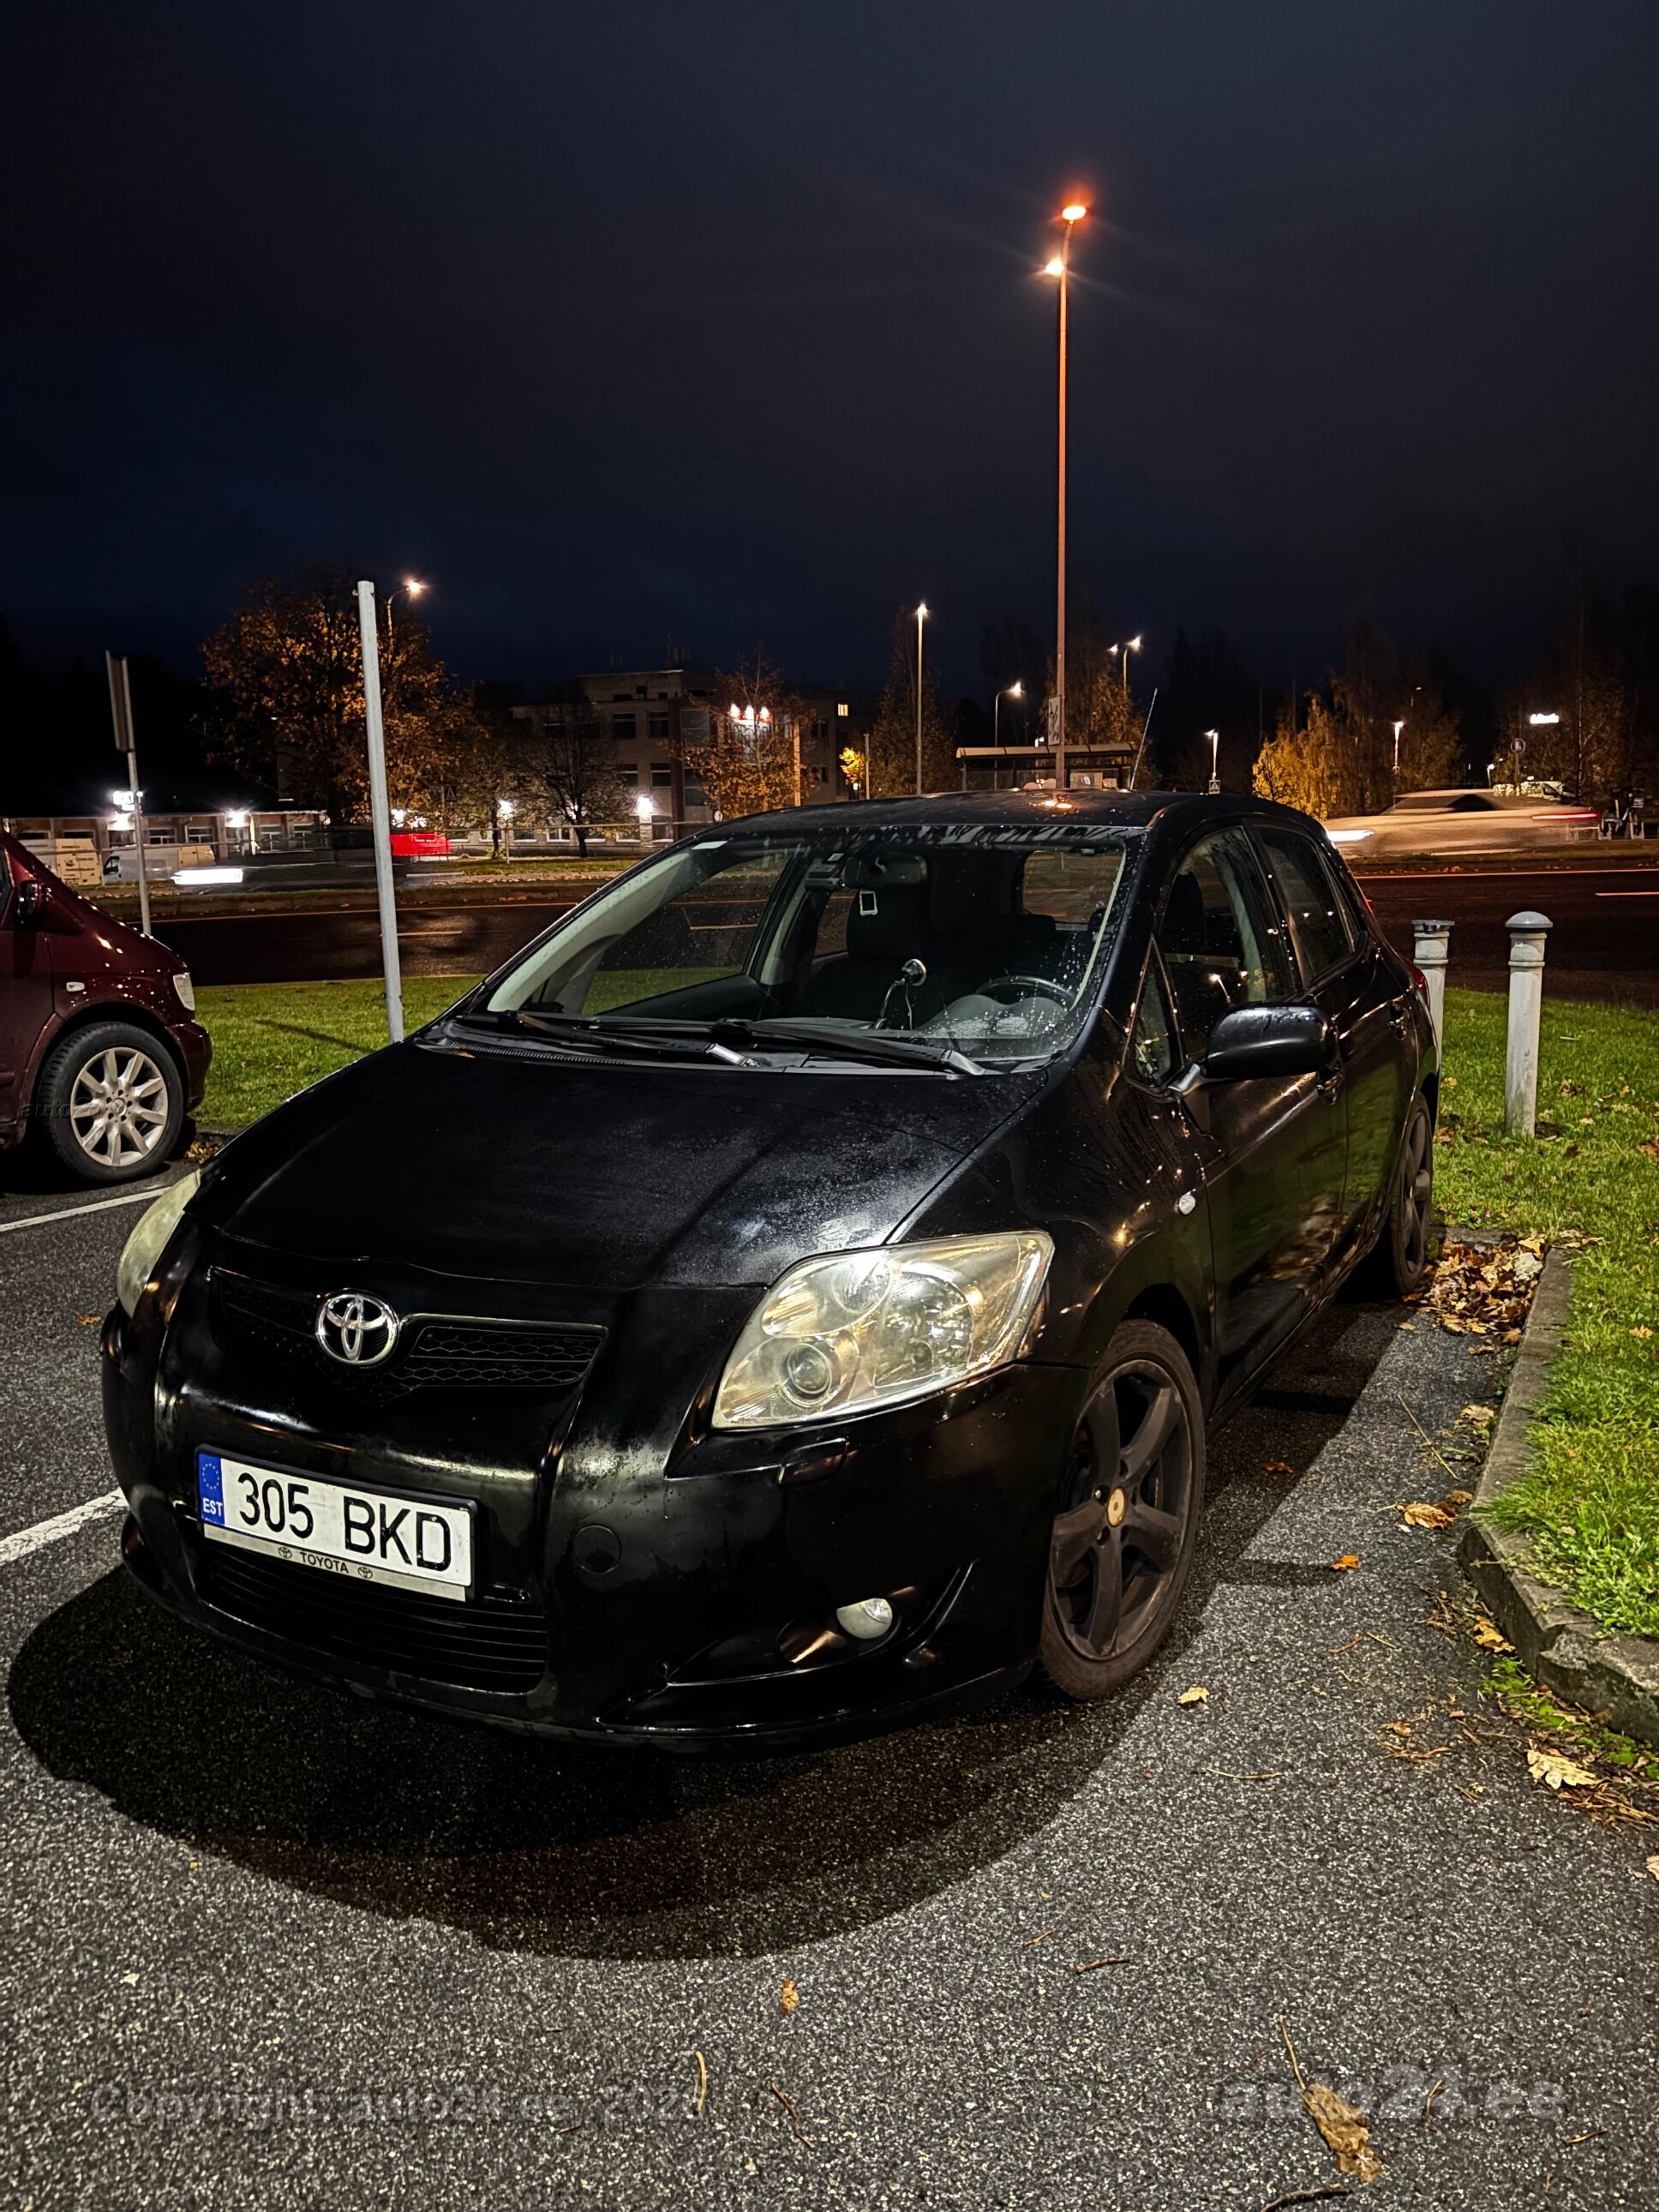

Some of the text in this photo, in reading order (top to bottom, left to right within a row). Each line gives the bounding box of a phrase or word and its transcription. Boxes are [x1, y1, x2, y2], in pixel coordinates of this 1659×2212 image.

[202, 1498, 223, 1517] EST
[237, 1472, 452, 1572] 305 BKD
[300, 1551, 350, 1574] TOYOTA
